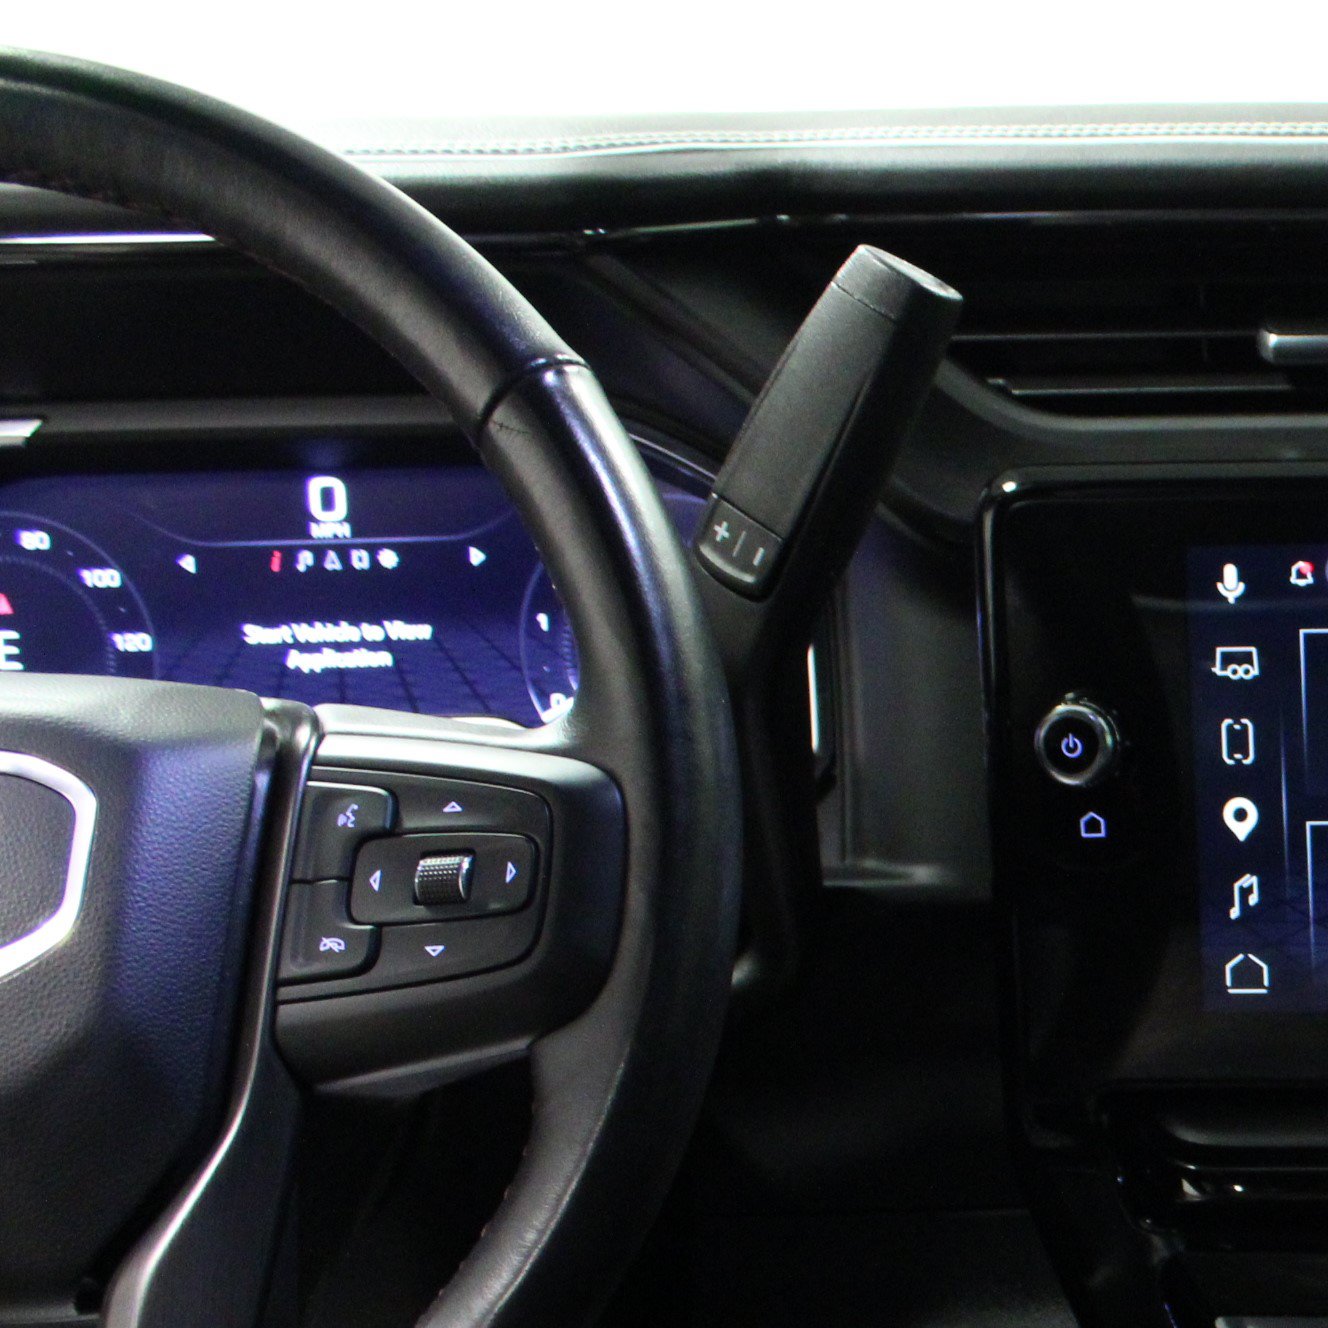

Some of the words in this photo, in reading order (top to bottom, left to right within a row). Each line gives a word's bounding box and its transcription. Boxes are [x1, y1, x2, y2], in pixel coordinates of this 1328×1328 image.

[307, 475, 348, 522] 0
[310, 522, 351, 538] MPH
[79, 568, 122, 588] 100
[111, 632, 153, 652] 120
[242, 623, 293, 645] Start
[293, 620, 361, 643] Vehicle
[361, 622, 385, 642] to
[384, 619, 433, 641] View
[286, 647, 393, 674] Application
